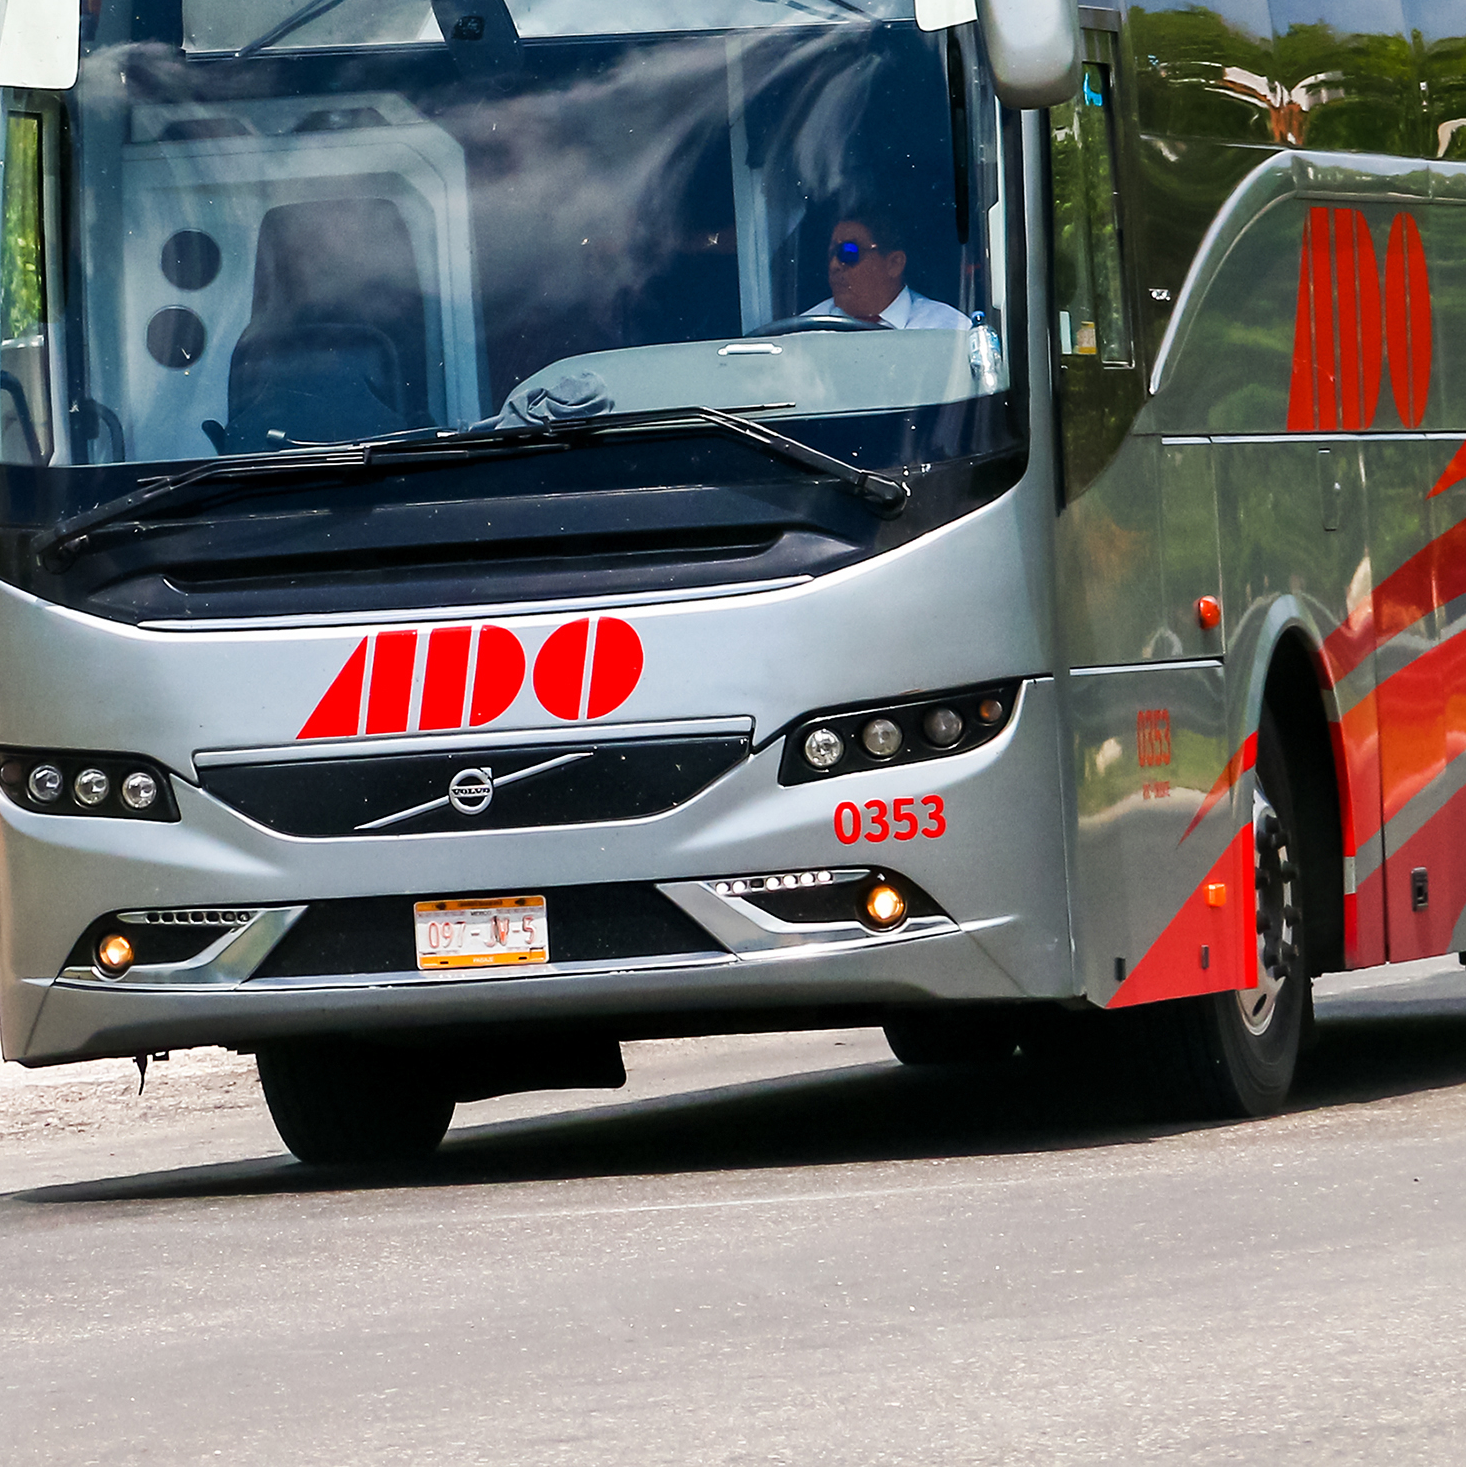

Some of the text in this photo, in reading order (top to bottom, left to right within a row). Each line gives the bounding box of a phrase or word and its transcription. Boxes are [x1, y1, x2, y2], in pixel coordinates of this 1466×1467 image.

[1287, 207, 1432, 431] ADO
[296, 616, 645, 739] ADO
[451, 786, 491, 796] VOLVO
[834, 794, 947, 845] 0353
